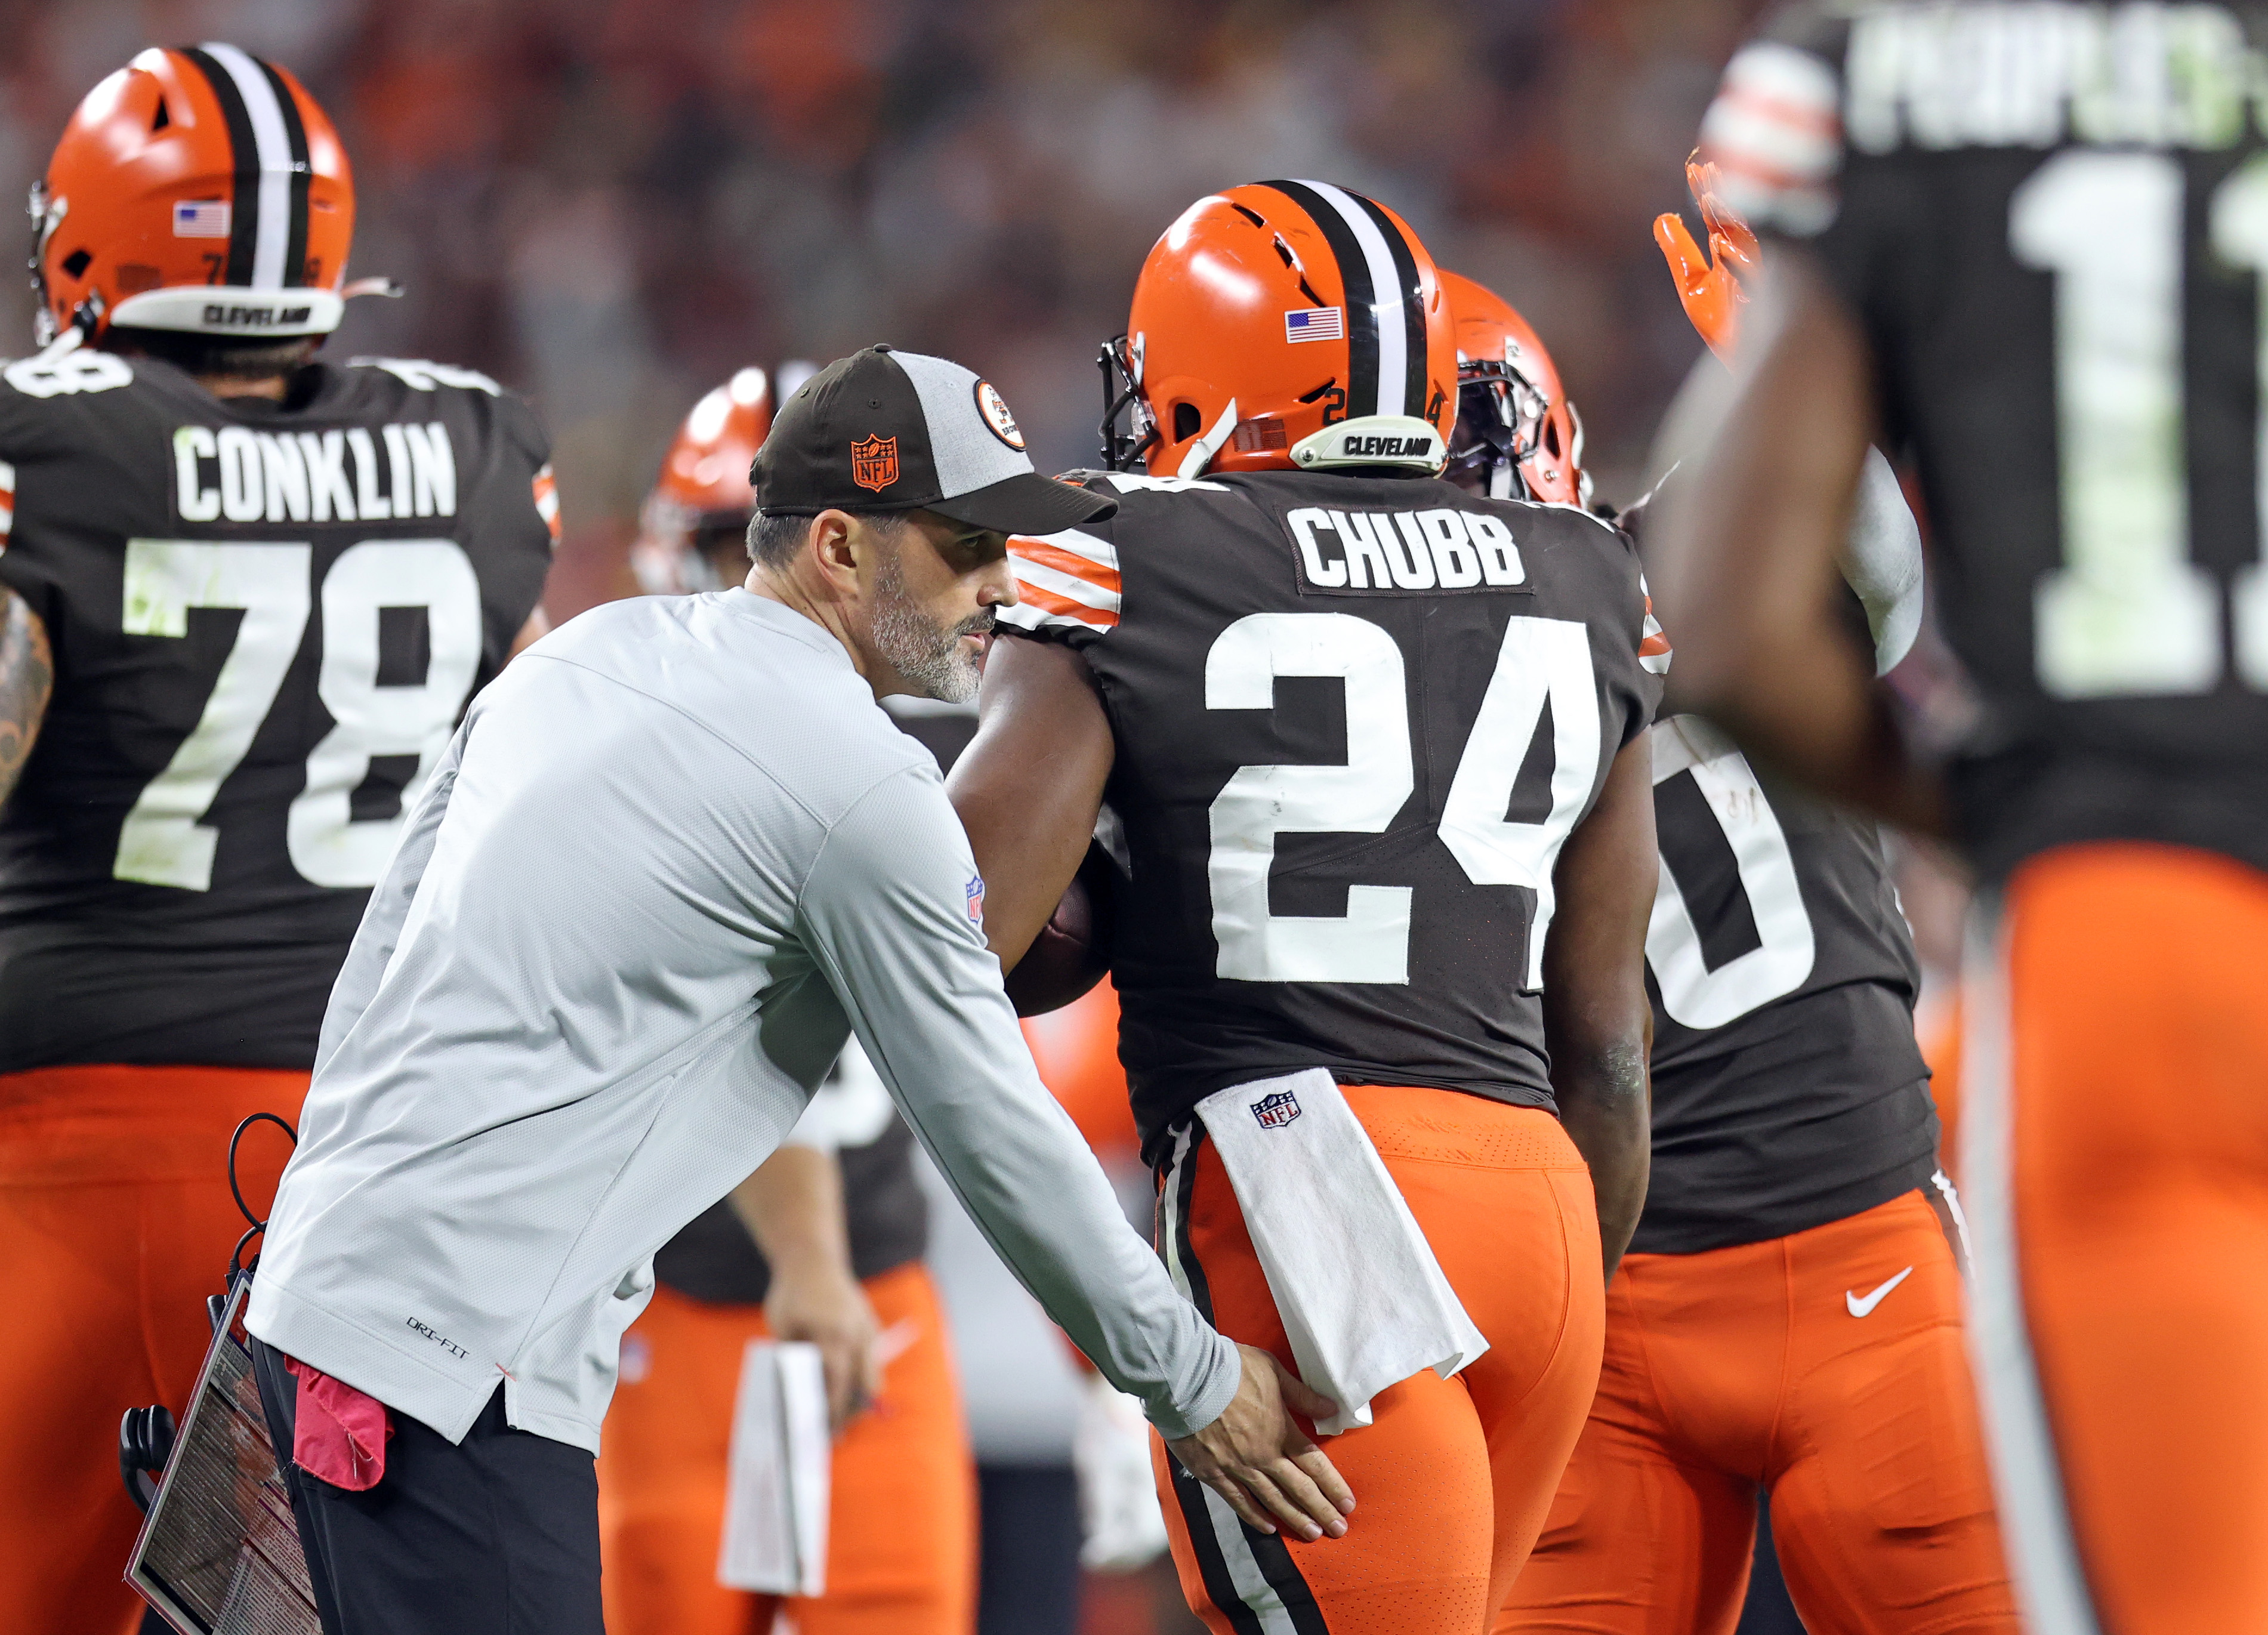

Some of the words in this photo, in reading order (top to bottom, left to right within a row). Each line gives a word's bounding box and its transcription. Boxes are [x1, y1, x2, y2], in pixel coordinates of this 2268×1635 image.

[203, 304, 311, 325] CLEVELAND
[1322, 388, 1346, 426] 2
[1426, 391, 1445, 430] 4
[1344, 436, 1432, 457] CLEVELAND
[172, 421, 458, 523] CONKLIN
[859, 458, 893, 482] NFL
[1286, 507, 1526, 590] CHUBB
[113, 538, 483, 891] 78
[1205, 612, 1601, 990] 24
[969, 896, 982, 919] NF
[1258, 1103, 1298, 1127] NFL
[406, 1316, 470, 1359] DRI-FIT
